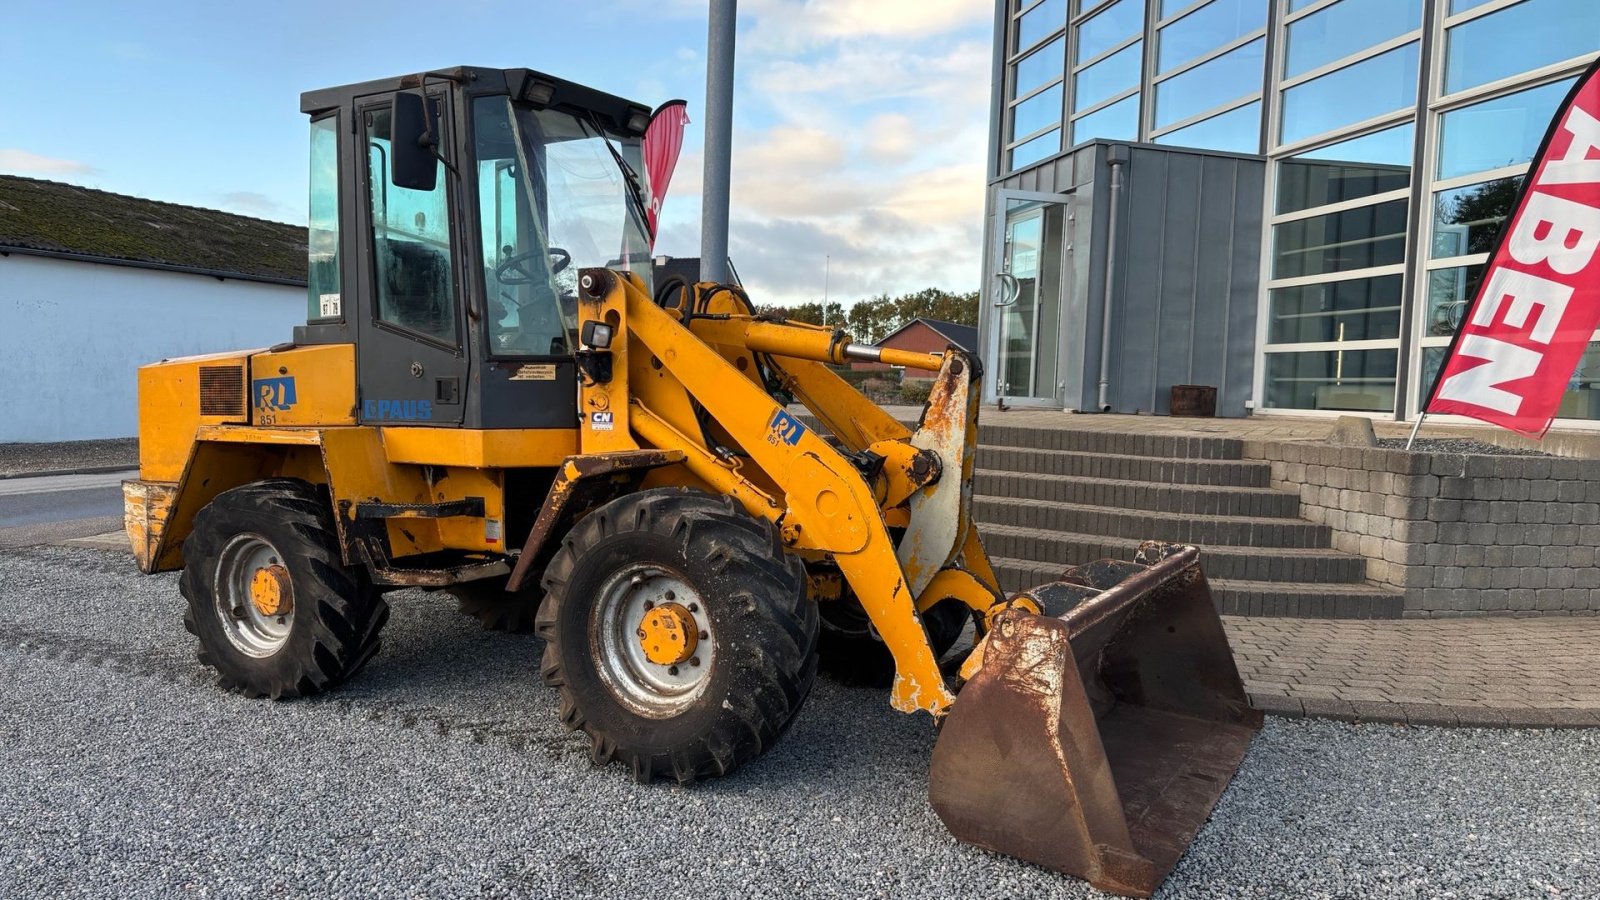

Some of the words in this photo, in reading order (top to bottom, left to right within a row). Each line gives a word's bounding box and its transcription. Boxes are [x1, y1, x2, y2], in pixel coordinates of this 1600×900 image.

[260, 415, 277, 425] 851
[593, 412, 611, 422] CN
[767, 434, 780, 447] 851
